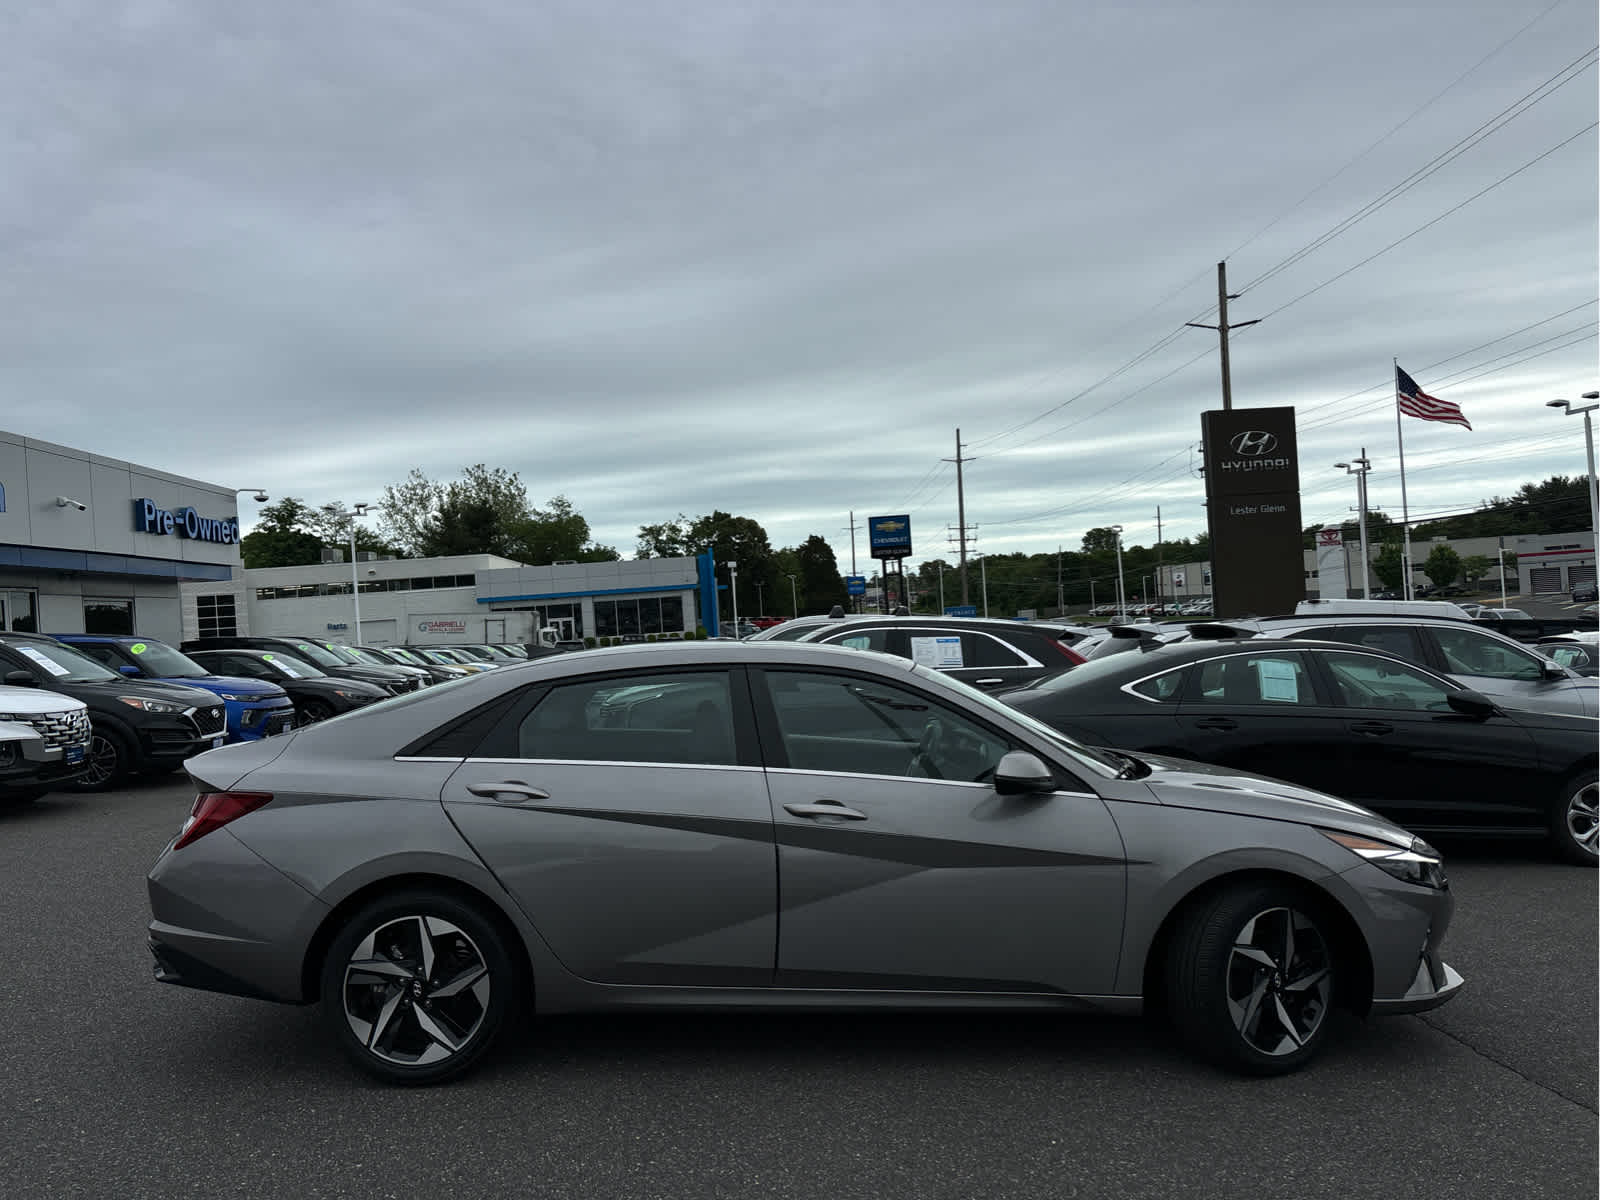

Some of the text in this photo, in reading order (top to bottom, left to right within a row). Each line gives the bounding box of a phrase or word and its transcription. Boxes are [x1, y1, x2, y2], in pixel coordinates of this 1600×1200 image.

[1221, 458, 1289, 472] HYUNDAI
[1230, 504, 1286, 515] Lester Glenn
[138, 498, 239, 544] Pre-Owned
[873, 536, 908, 544] CHEVROLET
